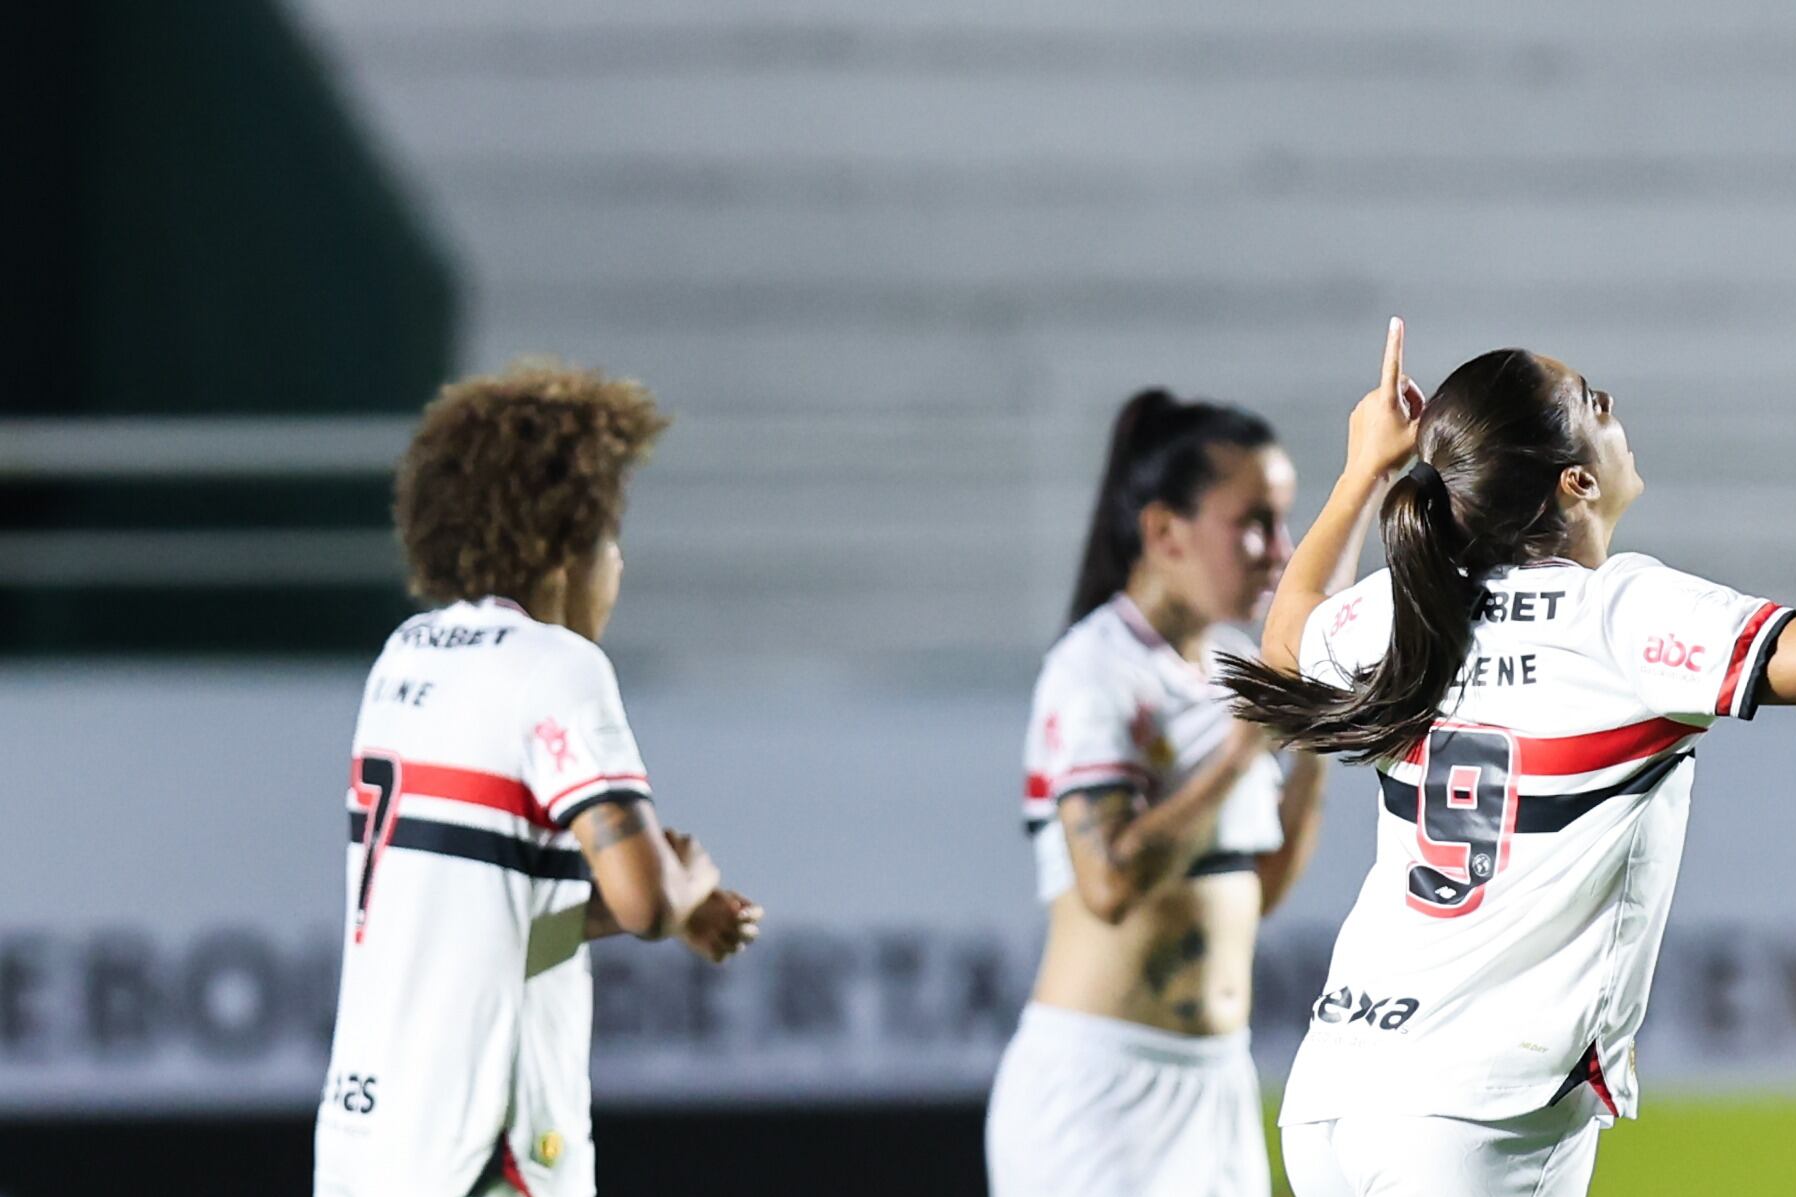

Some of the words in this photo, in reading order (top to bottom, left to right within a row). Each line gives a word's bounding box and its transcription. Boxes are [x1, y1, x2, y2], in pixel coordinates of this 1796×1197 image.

[1643, 633, 1706, 673] abc
[349, 747, 402, 944] 7
[1406, 719, 1523, 919] 9
